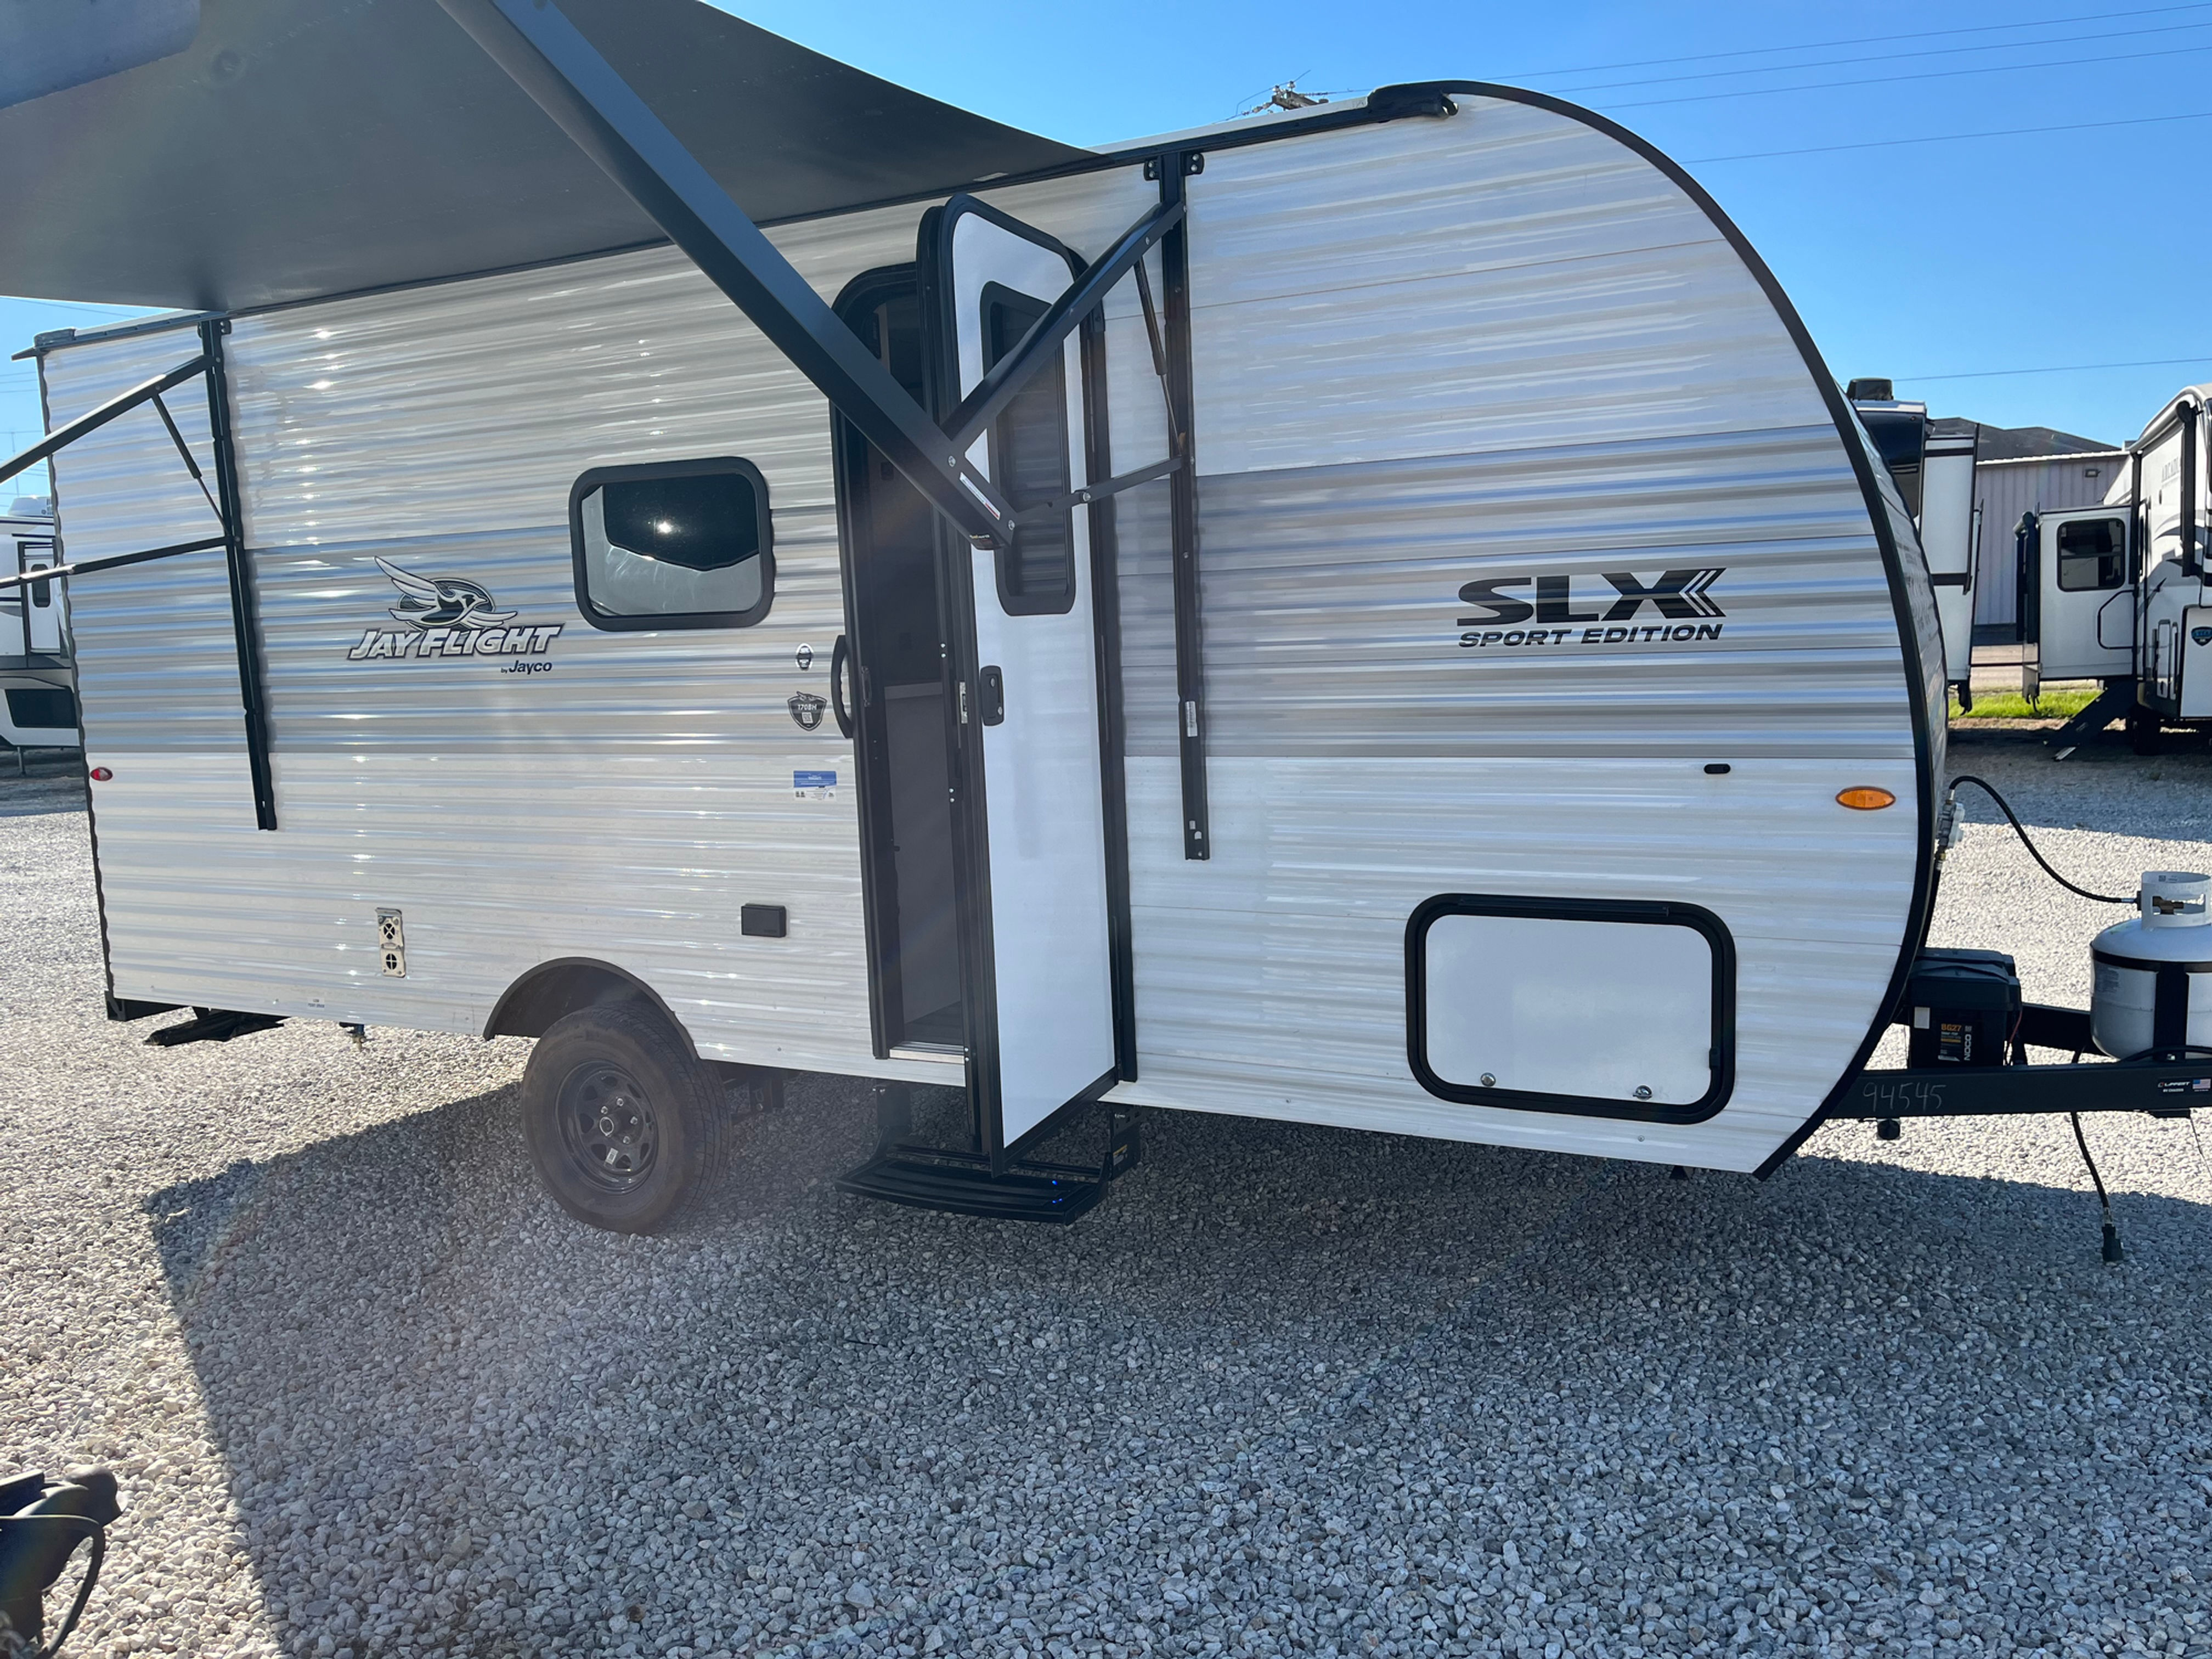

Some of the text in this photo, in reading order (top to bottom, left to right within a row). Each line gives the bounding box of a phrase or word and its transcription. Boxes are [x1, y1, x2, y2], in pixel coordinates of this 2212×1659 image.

[1457, 567, 1726, 626] SLX
[1459, 624, 1723, 647] SPORT EDITION
[509, 660, 552, 675] Jayco
[1863, 1082, 1946, 1112] 94545
